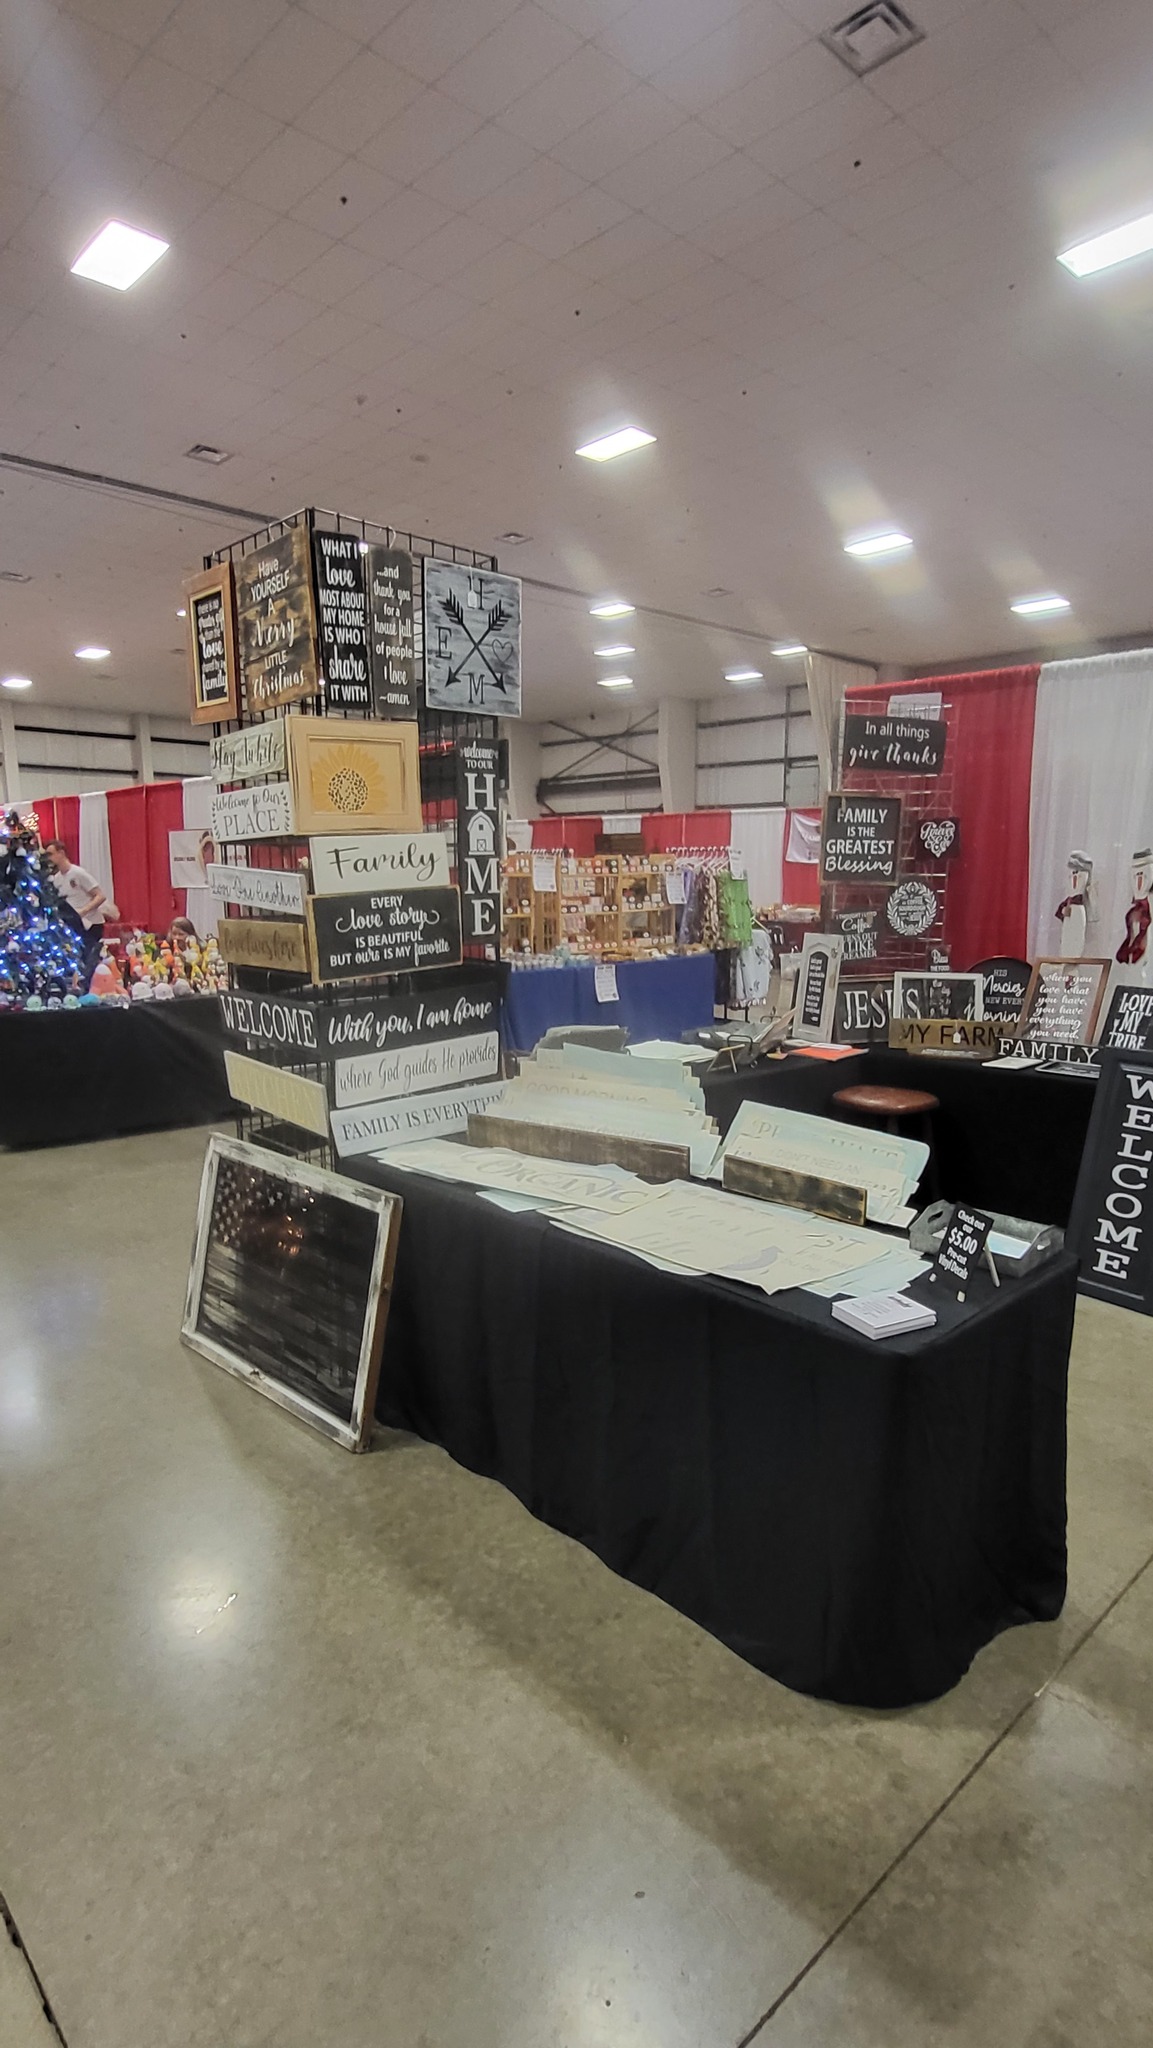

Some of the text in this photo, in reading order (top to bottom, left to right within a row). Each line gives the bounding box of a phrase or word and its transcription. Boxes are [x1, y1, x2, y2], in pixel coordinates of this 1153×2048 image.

[320, 538, 358, 560] WHAT I
[258, 559, 279, 578] Have
[325, 556, 356, 587] love
[251, 570, 290, 603] YOURSELF
[373, 579, 411, 606] thank you
[267, 598, 275, 617] A
[320, 588, 365, 610] MOST ABOUT
[383, 603, 400, 617] for a
[323, 607, 365, 627] MY HOME
[252, 617, 295, 648] Merry
[324, 626, 367, 646] IS WHO I
[374, 613, 412, 646] house full
[202, 638, 224, 660] love
[265, 650, 287, 670] LITTLE
[376, 641, 413, 660] of people
[329, 645, 367, 682] share
[389, 661, 408, 686] love
[253, 665, 305, 699] Christmas
[330, 684, 368, 703] IT WITH
[865, 721, 930, 742] In all things
[465, 759, 494, 770] TO OUR
[849, 742, 937, 767] give thanks
[216, 794, 249, 811] Welcome
[262, 788, 280, 805] Our
[223, 809, 280, 837] PLACE
[837, 807, 888, 824] FAMILY
[847, 826, 876, 837] IS THE
[826, 839, 895, 855] GREATEST
[326, 842, 440, 882] Family
[825, 855, 893, 876] Blessing
[370, 895, 403, 909] EVERY
[335, 906, 440, 933] love story
[356, 930, 424, 949] IS BEAUTIFUL
[843, 931, 878, 942] URNS OUT
[330, 938, 450, 967] BUT ours IS MY favorite
[993, 969, 1007, 977] HIS
[1043, 972, 1093, 987] when you
[1039, 984, 1090, 995] love what
[843, 988, 921, 1030] JESUS
[985, 996, 1024, 1006] NEW EVER
[1032, 1005, 1083, 1017] you have
[1035, 997, 1057, 1007] you
[1118, 992, 1153, 1017] LOVE
[220, 995, 318, 1049] WELCOME
[329, 997, 492, 1048] With you, I am home
[964, 1003, 1021, 1023] Mornin
[1028, 1016, 1081, 1030] everything
[1119, 1010, 1147, 1034] MY
[899, 1023, 1004, 1047] MY FARM
[1027, 1029, 1079, 1040] you need.
[1108, 1031, 1147, 1051] TRIBE
[998, 1038, 1099, 1064] FAMILY
[340, 1036, 496, 1092] where God guides He provides
[342, 1114, 401, 1141] FAMILY
[405, 1110, 421, 1128] IS
[1092, 1074, 1153, 1280] WELCOME
[957, 1210, 986, 1232] Check out
[962, 1223, 974, 1234] our
[948, 1226, 978, 1255] $5.00
[938, 1253, 969, 1280] Vinyl Decals
[947, 1246, 968, 1265] Pre-cut
